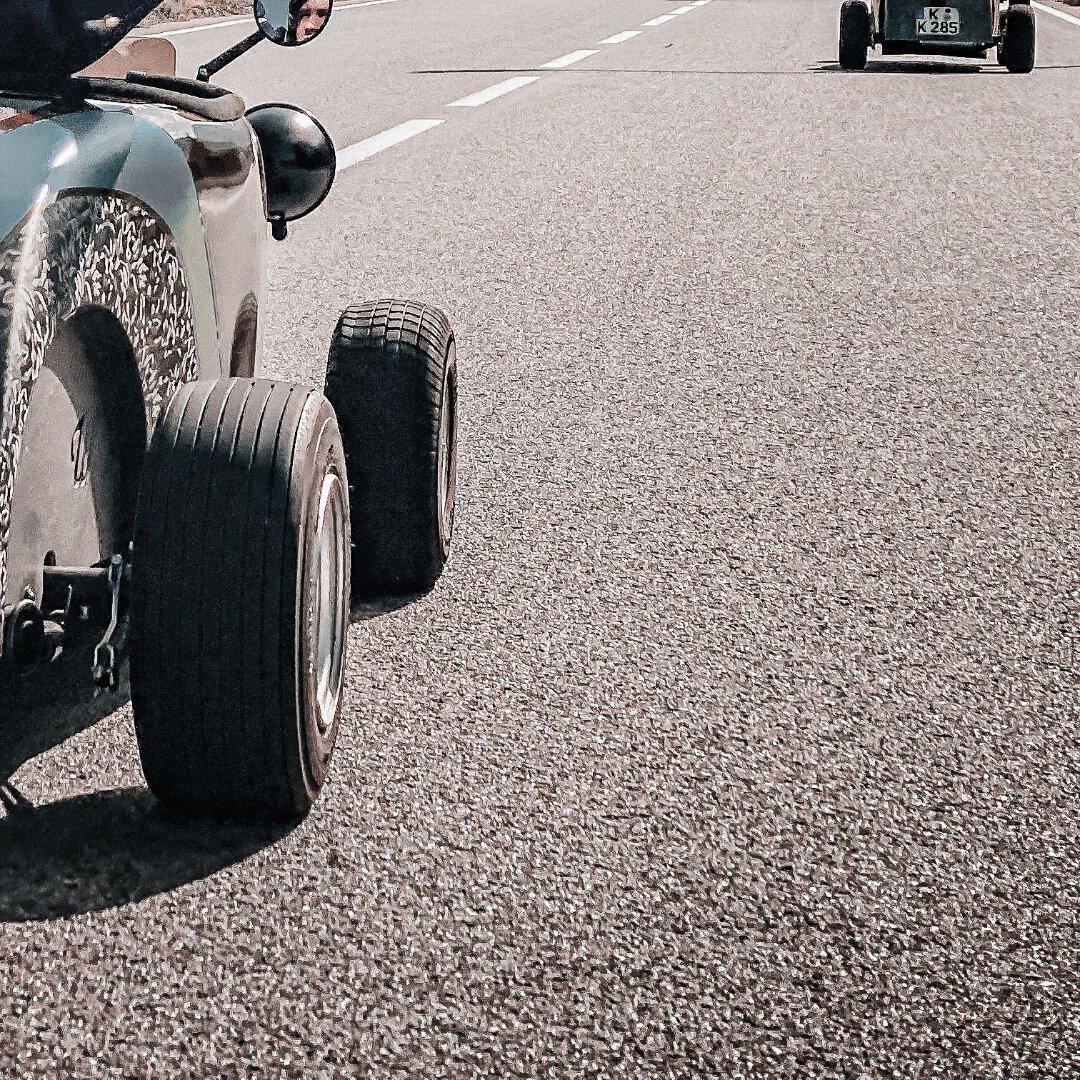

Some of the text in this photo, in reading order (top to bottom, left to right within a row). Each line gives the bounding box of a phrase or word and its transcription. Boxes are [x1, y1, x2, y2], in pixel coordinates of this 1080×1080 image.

[929, 8, 939, 20] K
[917, 21, 958, 34] K 285
